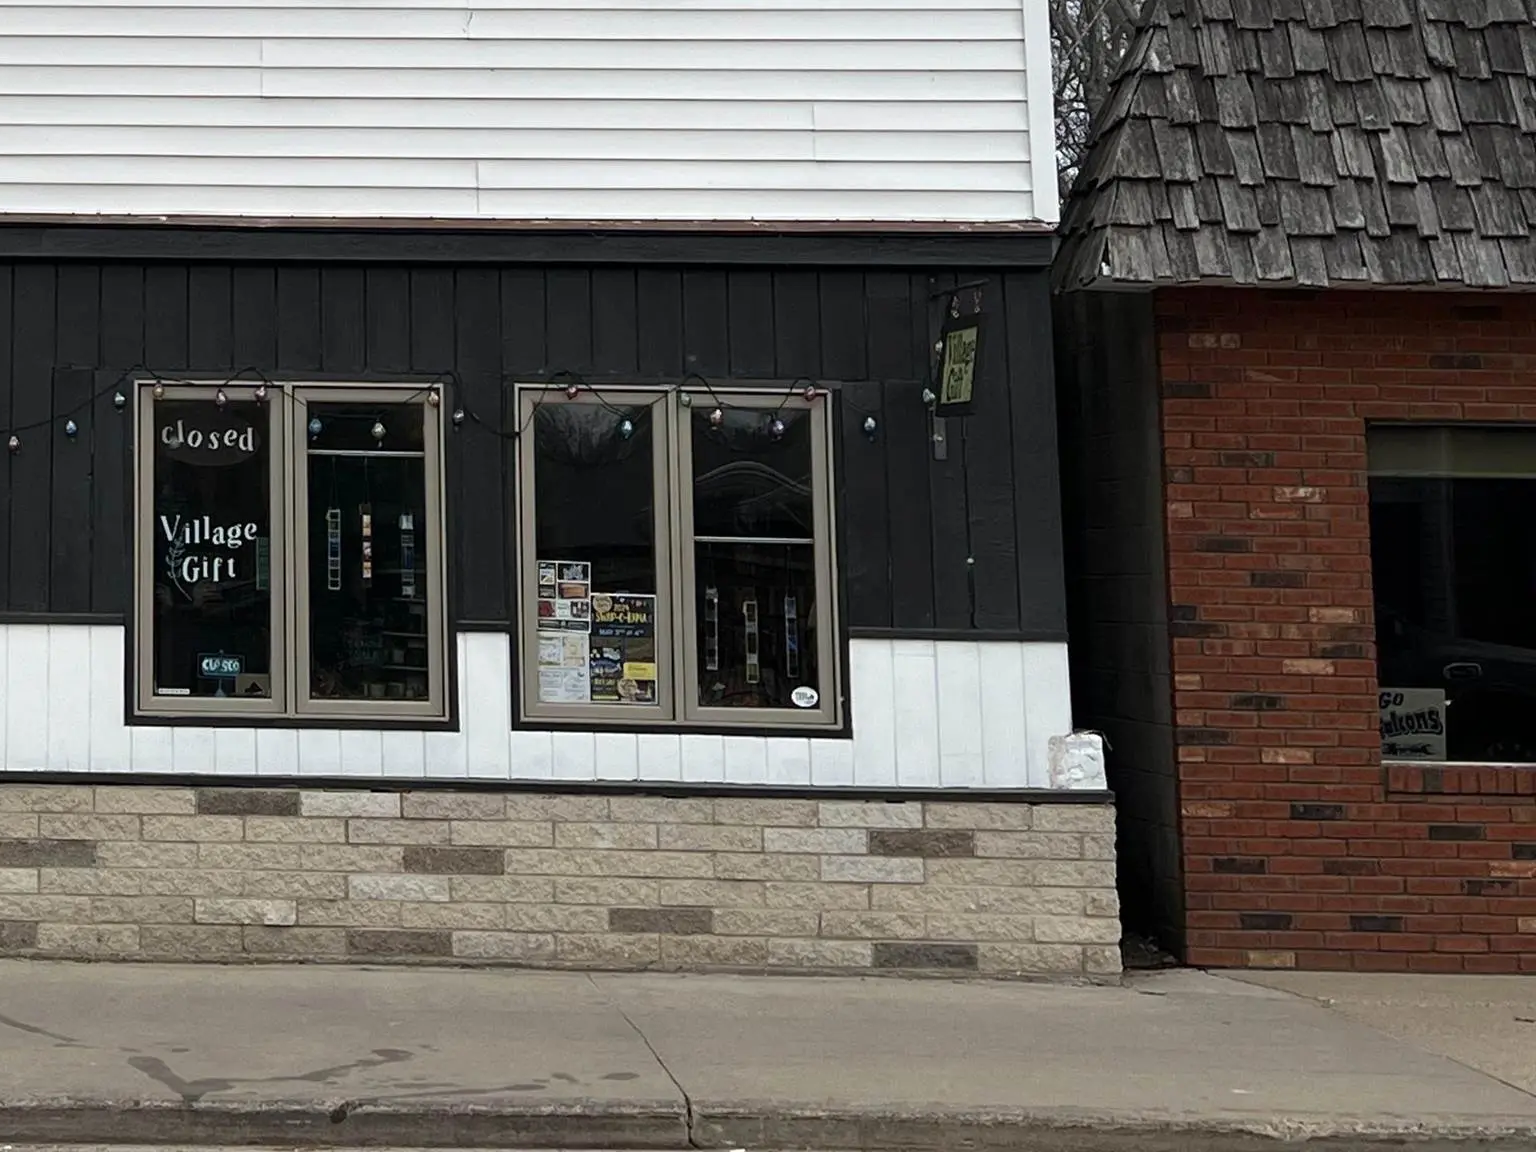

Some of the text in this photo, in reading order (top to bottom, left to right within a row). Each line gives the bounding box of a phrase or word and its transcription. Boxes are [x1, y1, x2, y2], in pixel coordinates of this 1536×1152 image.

[161, 419, 254, 452] closed
[160, 514, 258, 549] Village
[181, 555, 236, 582] Gift
[1380, 709, 1443, 737] alcons
